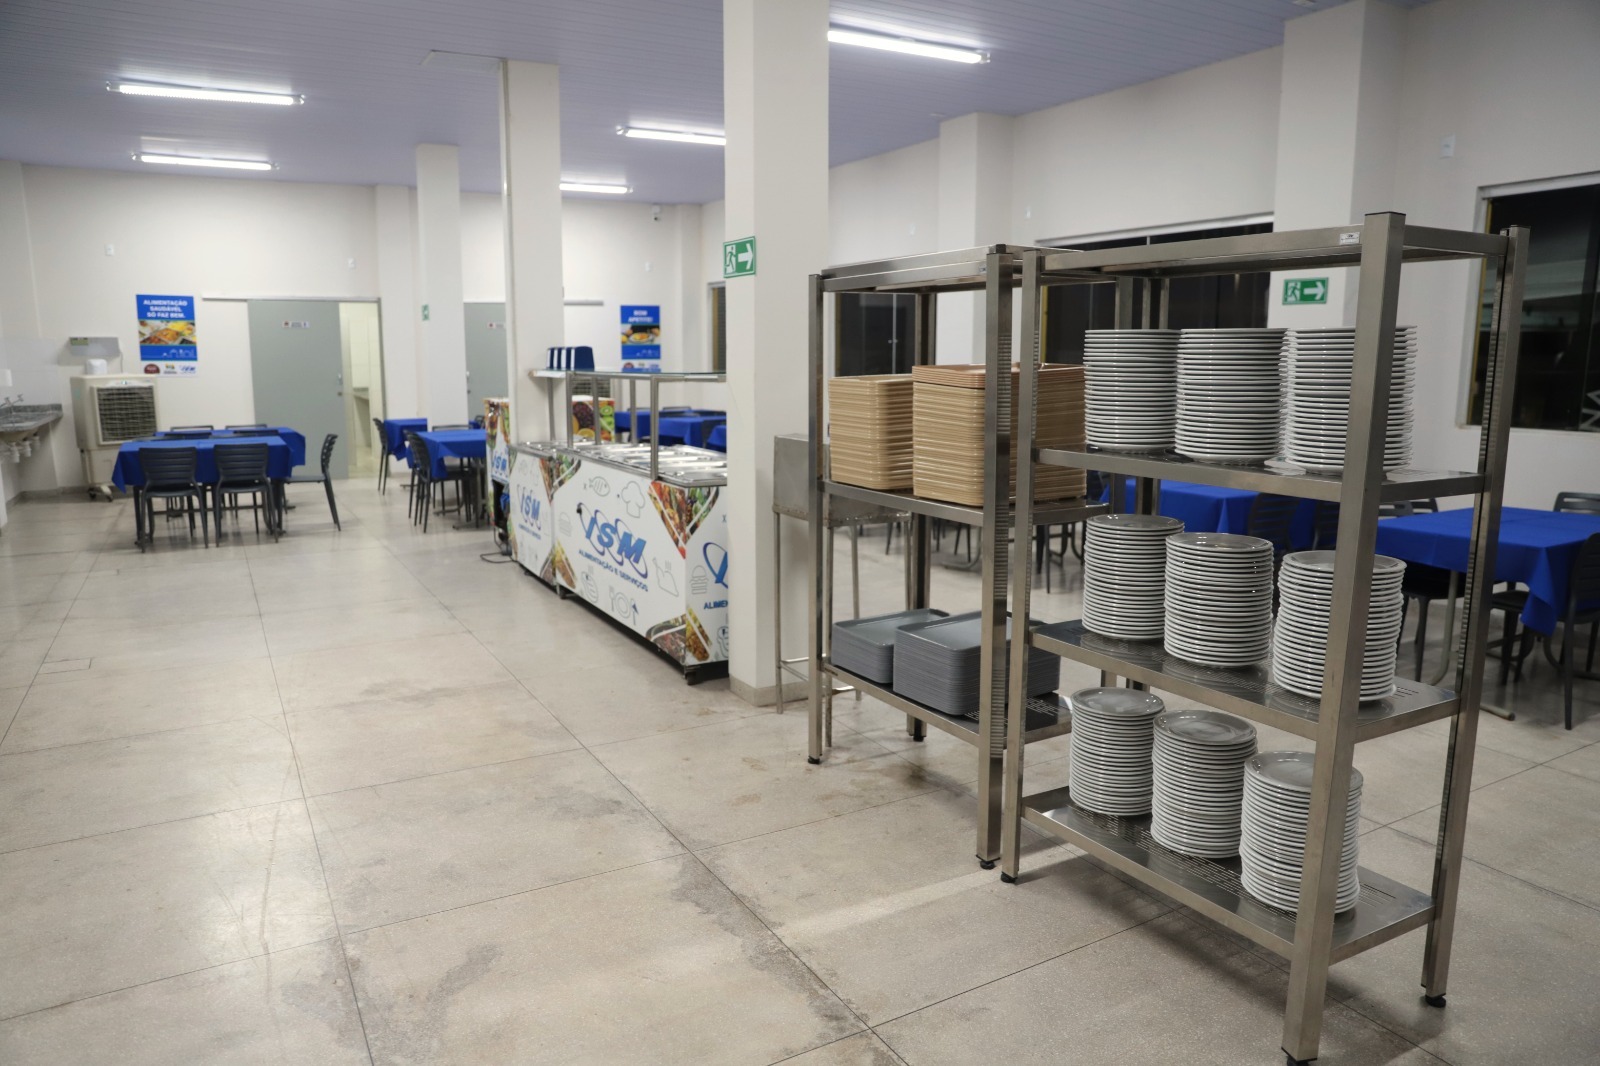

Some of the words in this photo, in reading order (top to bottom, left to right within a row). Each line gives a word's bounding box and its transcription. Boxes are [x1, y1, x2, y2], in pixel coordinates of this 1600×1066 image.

[520, 493, 540, 520] ISM
[585, 516, 647, 564] ISM
[578, 548, 614, 573] ALIMENTAÇÃO
[619, 570, 649, 592] SERVIÇOS
